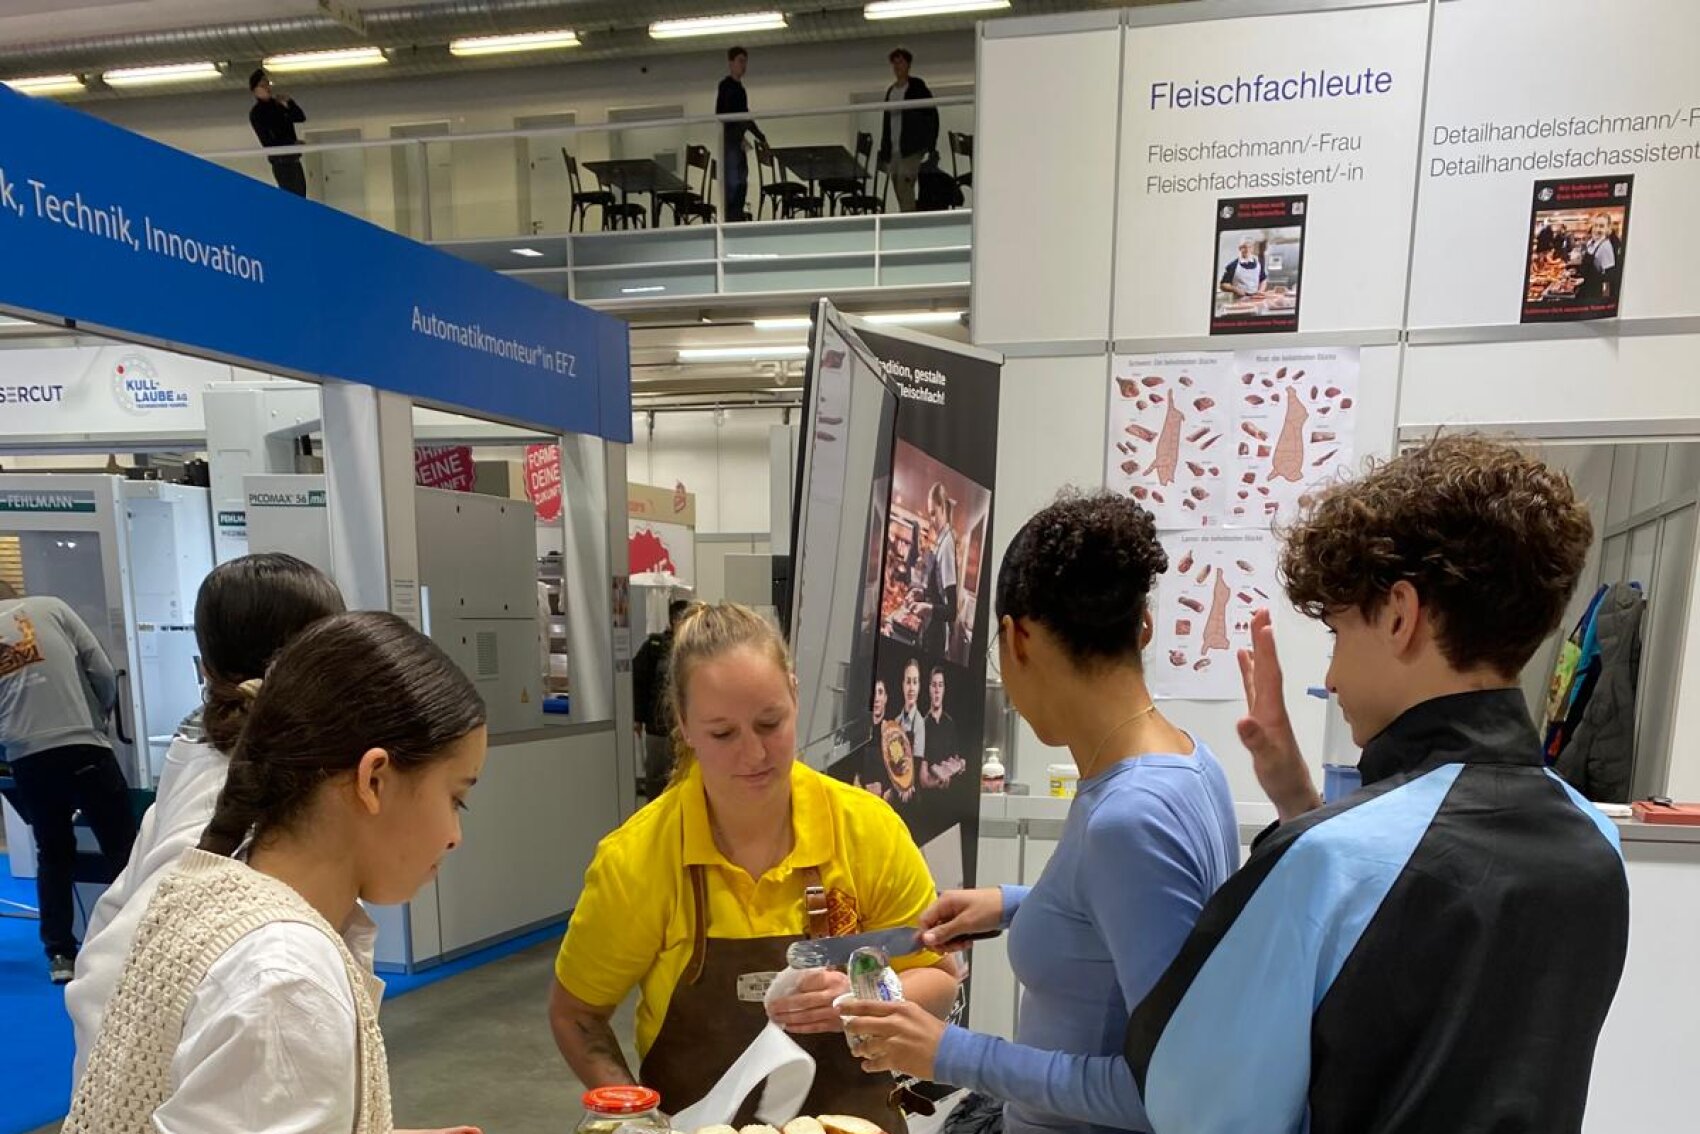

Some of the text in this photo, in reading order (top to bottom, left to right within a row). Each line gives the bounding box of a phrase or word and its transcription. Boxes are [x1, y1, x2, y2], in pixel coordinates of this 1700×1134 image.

[1150, 67, 1393, 110] Fleischfachleute
[1147, 132, 1362, 163] Fleischfachmann/-Frau
[1146, 162, 1364, 194] Fleischfachassistent/-in
[27, 179, 140, 251] Technik,
[145, 216, 265, 284] Innovation
[555, 351, 577, 378] EFZ
[914, 368, 946, 386] gestalte
[135, 390, 174, 402] LAUBE
[416, 453, 464, 484] EINE
[531, 463, 561, 490] DEINE
[6, 495, 74, 509] FEHLMANN
